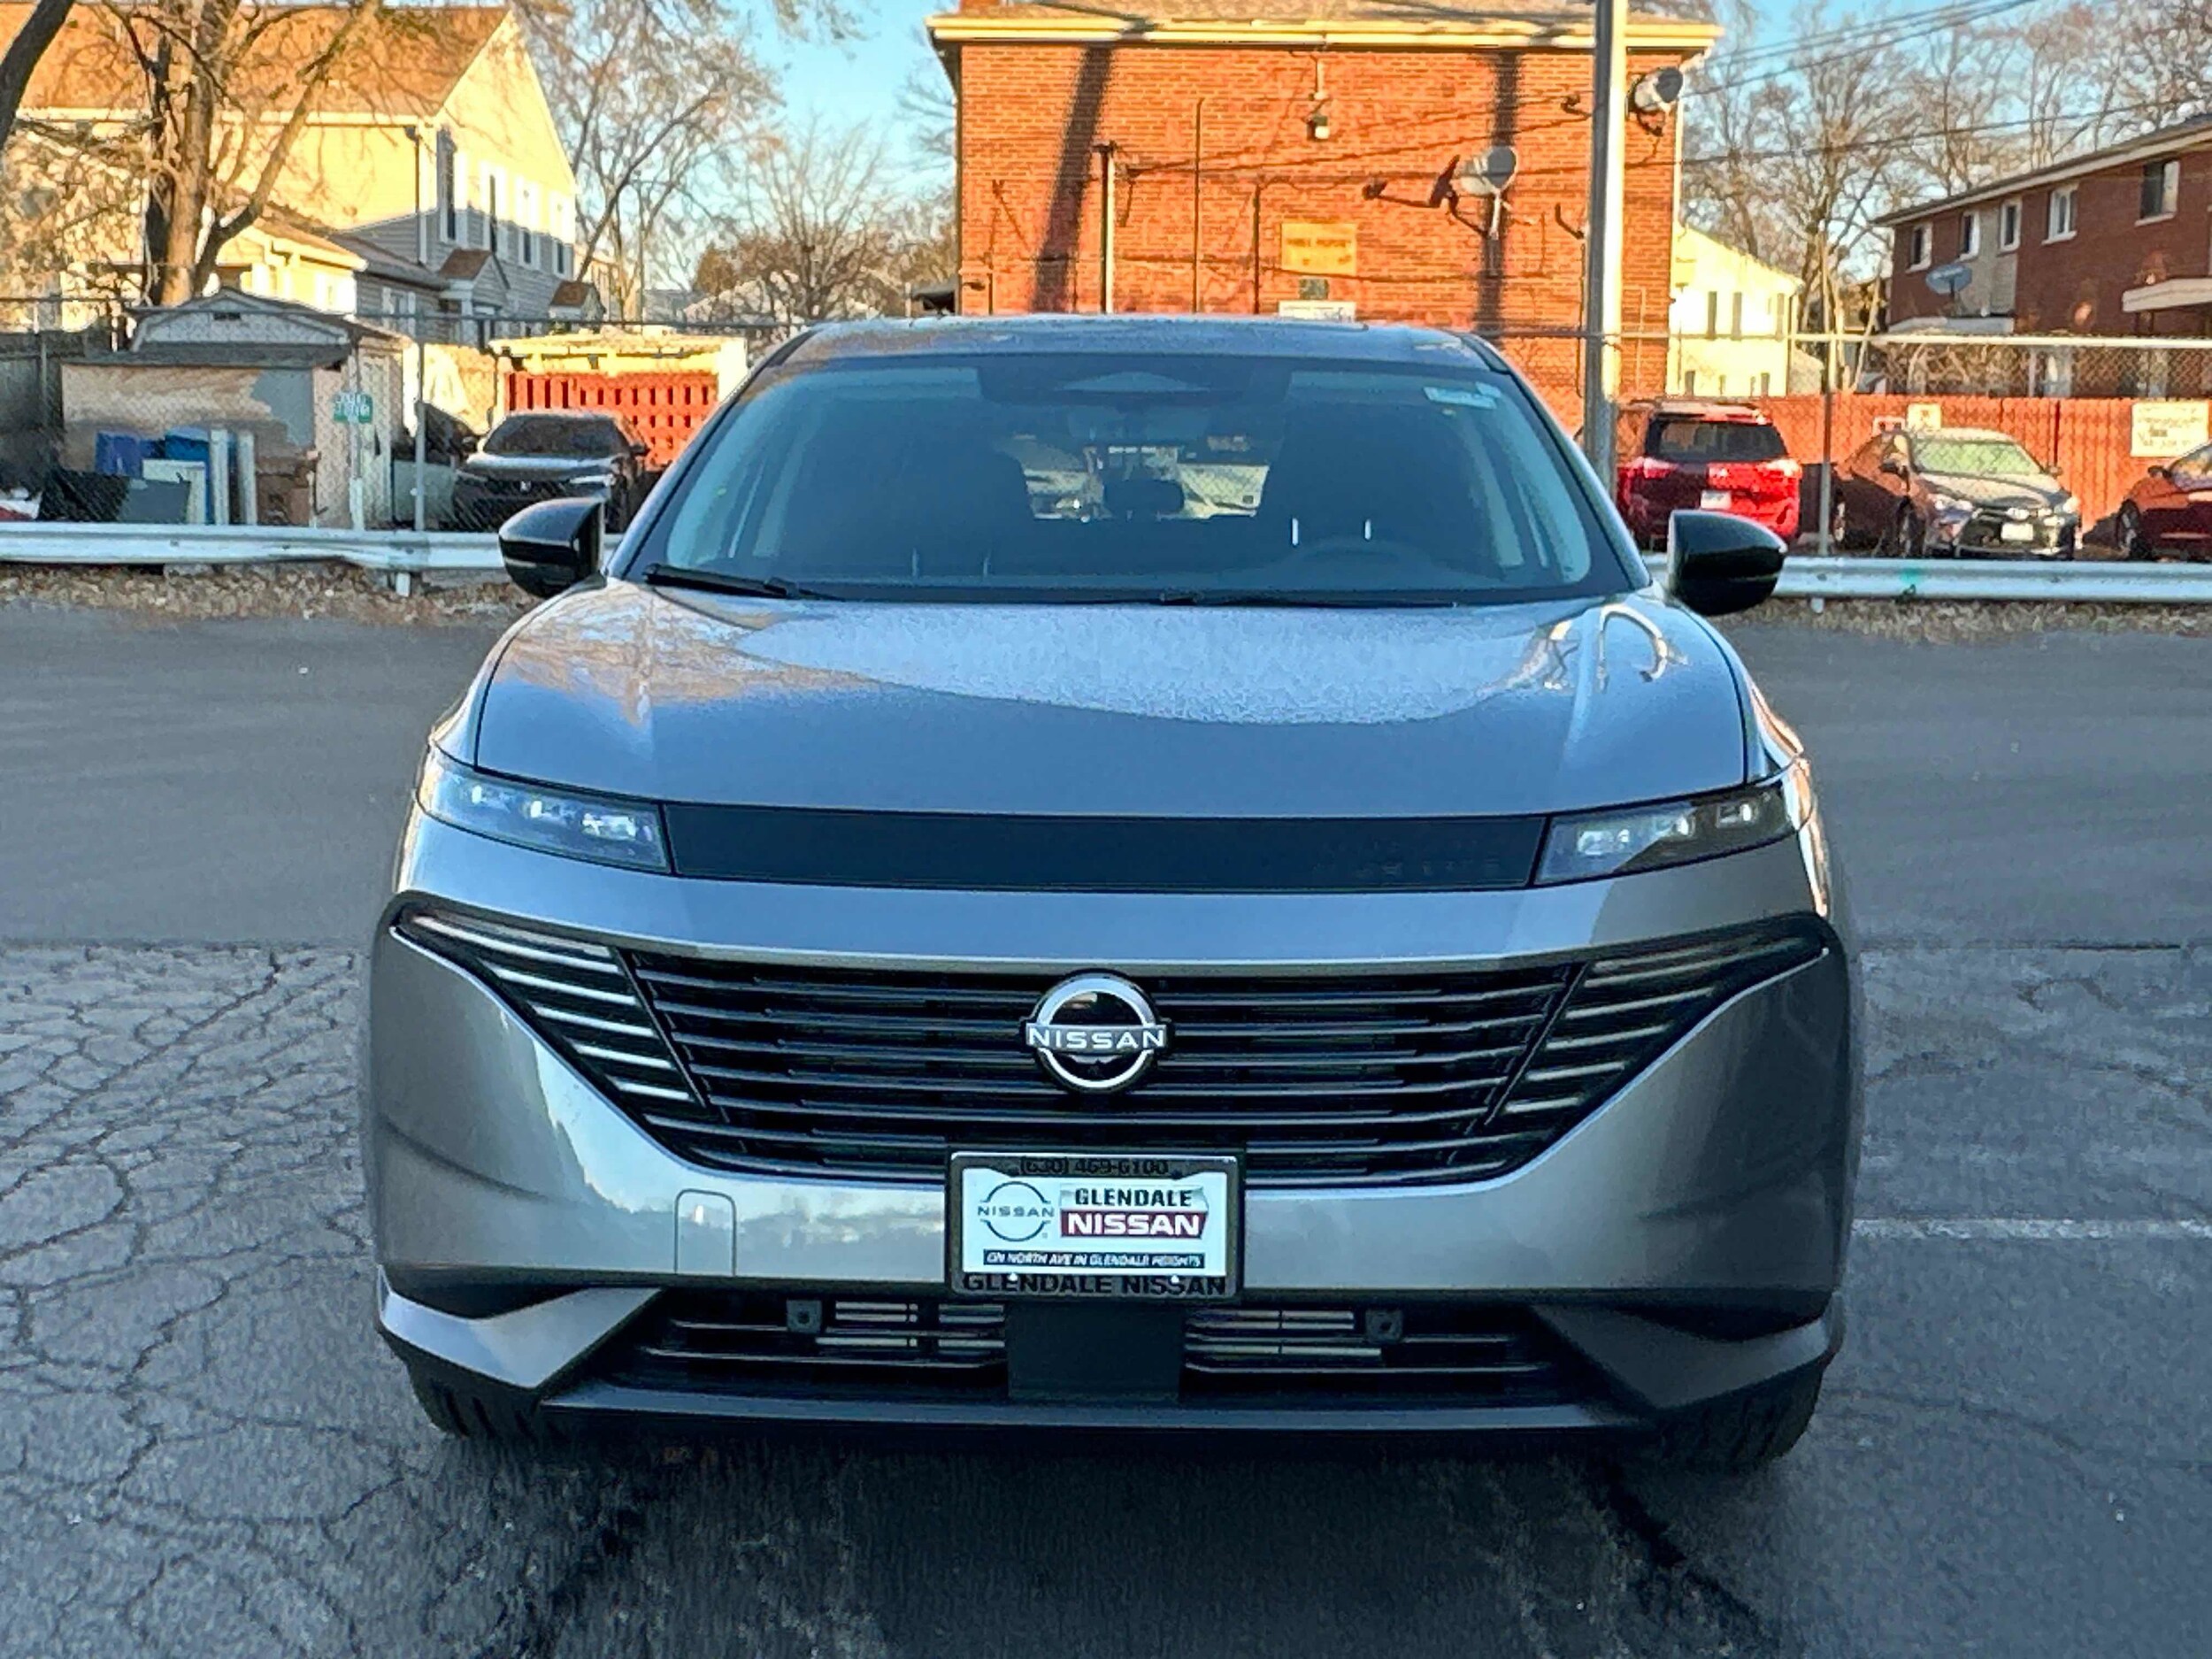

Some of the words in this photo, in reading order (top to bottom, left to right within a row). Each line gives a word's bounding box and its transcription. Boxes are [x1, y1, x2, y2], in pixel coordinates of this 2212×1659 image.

[1028, 1026, 1164, 1049] NISSAN
[1075, 1187, 1193, 1207] GLENDALE
[977, 1206, 1056, 1218] NISSAN
[1067, 1212, 1200, 1236] NISSAN
[1007, 1252, 1048, 1264] NORTH
[1048, 1253, 1072, 1265] AVE
[1073, 1254, 1087, 1266] IN
[1089, 1254, 1149, 1267] GLENDALE
[963, 1273, 1113, 1294] GLENDALE
[1120, 1276, 1226, 1295] NISSAN
